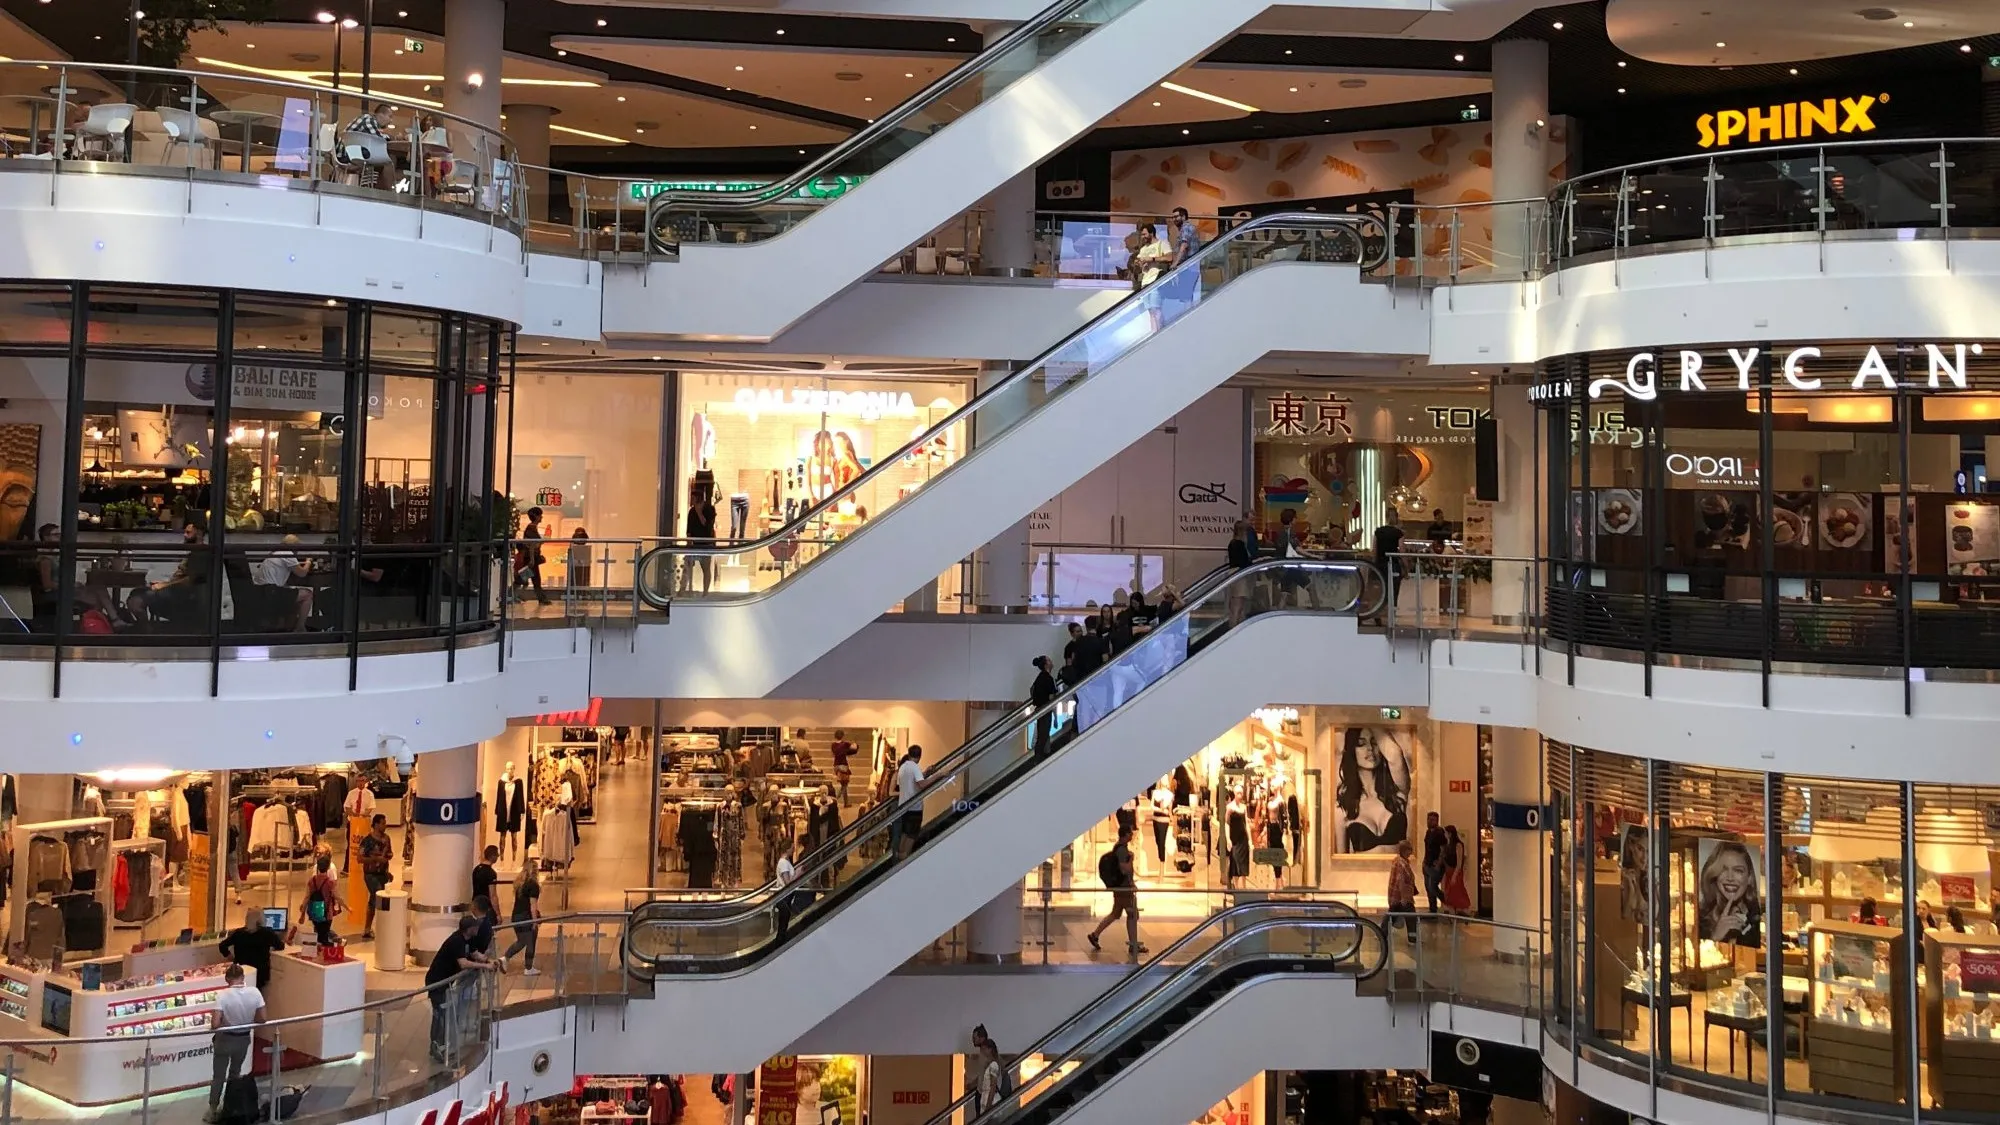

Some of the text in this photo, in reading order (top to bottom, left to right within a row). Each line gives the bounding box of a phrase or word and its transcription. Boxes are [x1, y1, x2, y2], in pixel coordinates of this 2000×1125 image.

[234, 366, 317, 388] BALI CAFE
[1588, 344, 1967, 400] GRYCAN
[233, 386, 241, 396] &
[1266, 390, 1354, 437] 東京
[440, 802, 453, 821] 0
[1526, 809, 1538, 827] 0
